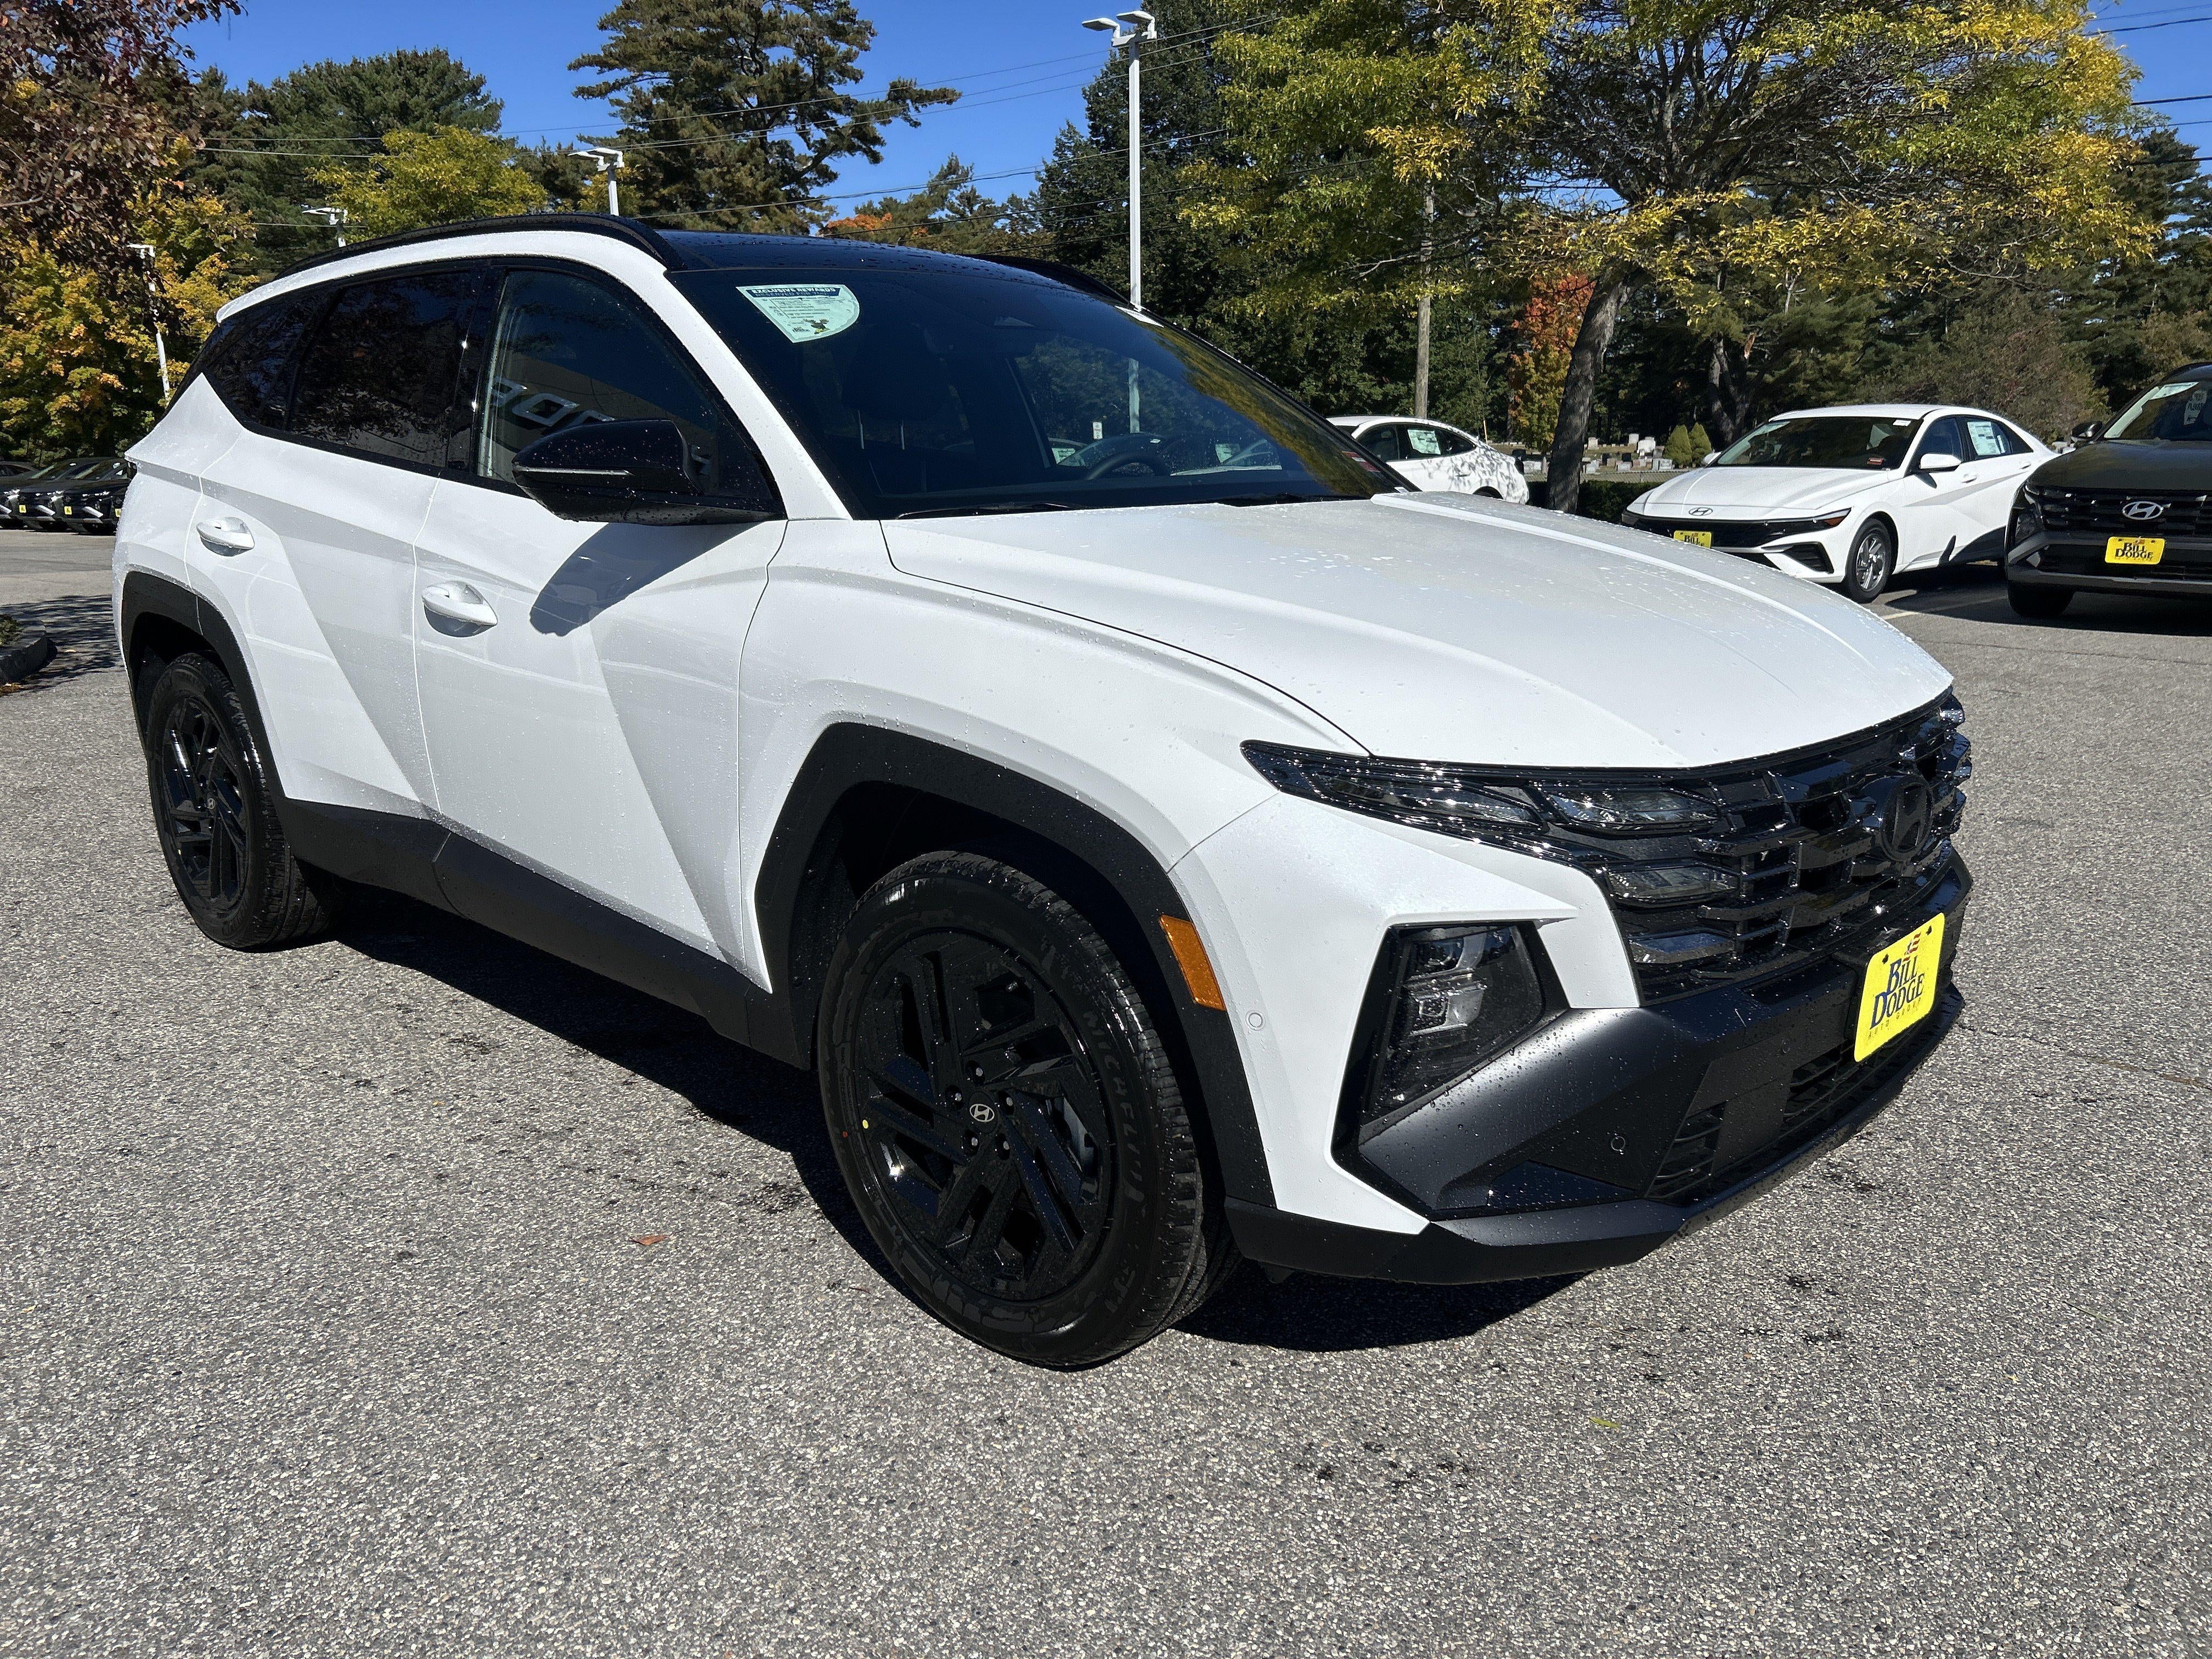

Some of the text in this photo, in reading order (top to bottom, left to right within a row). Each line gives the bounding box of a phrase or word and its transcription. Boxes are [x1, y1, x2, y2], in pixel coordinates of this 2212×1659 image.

[2115, 549, 2153, 558] DODGE
[1887, 955, 1918, 994] BILL
[1869, 973, 1925, 1030] DODGE
